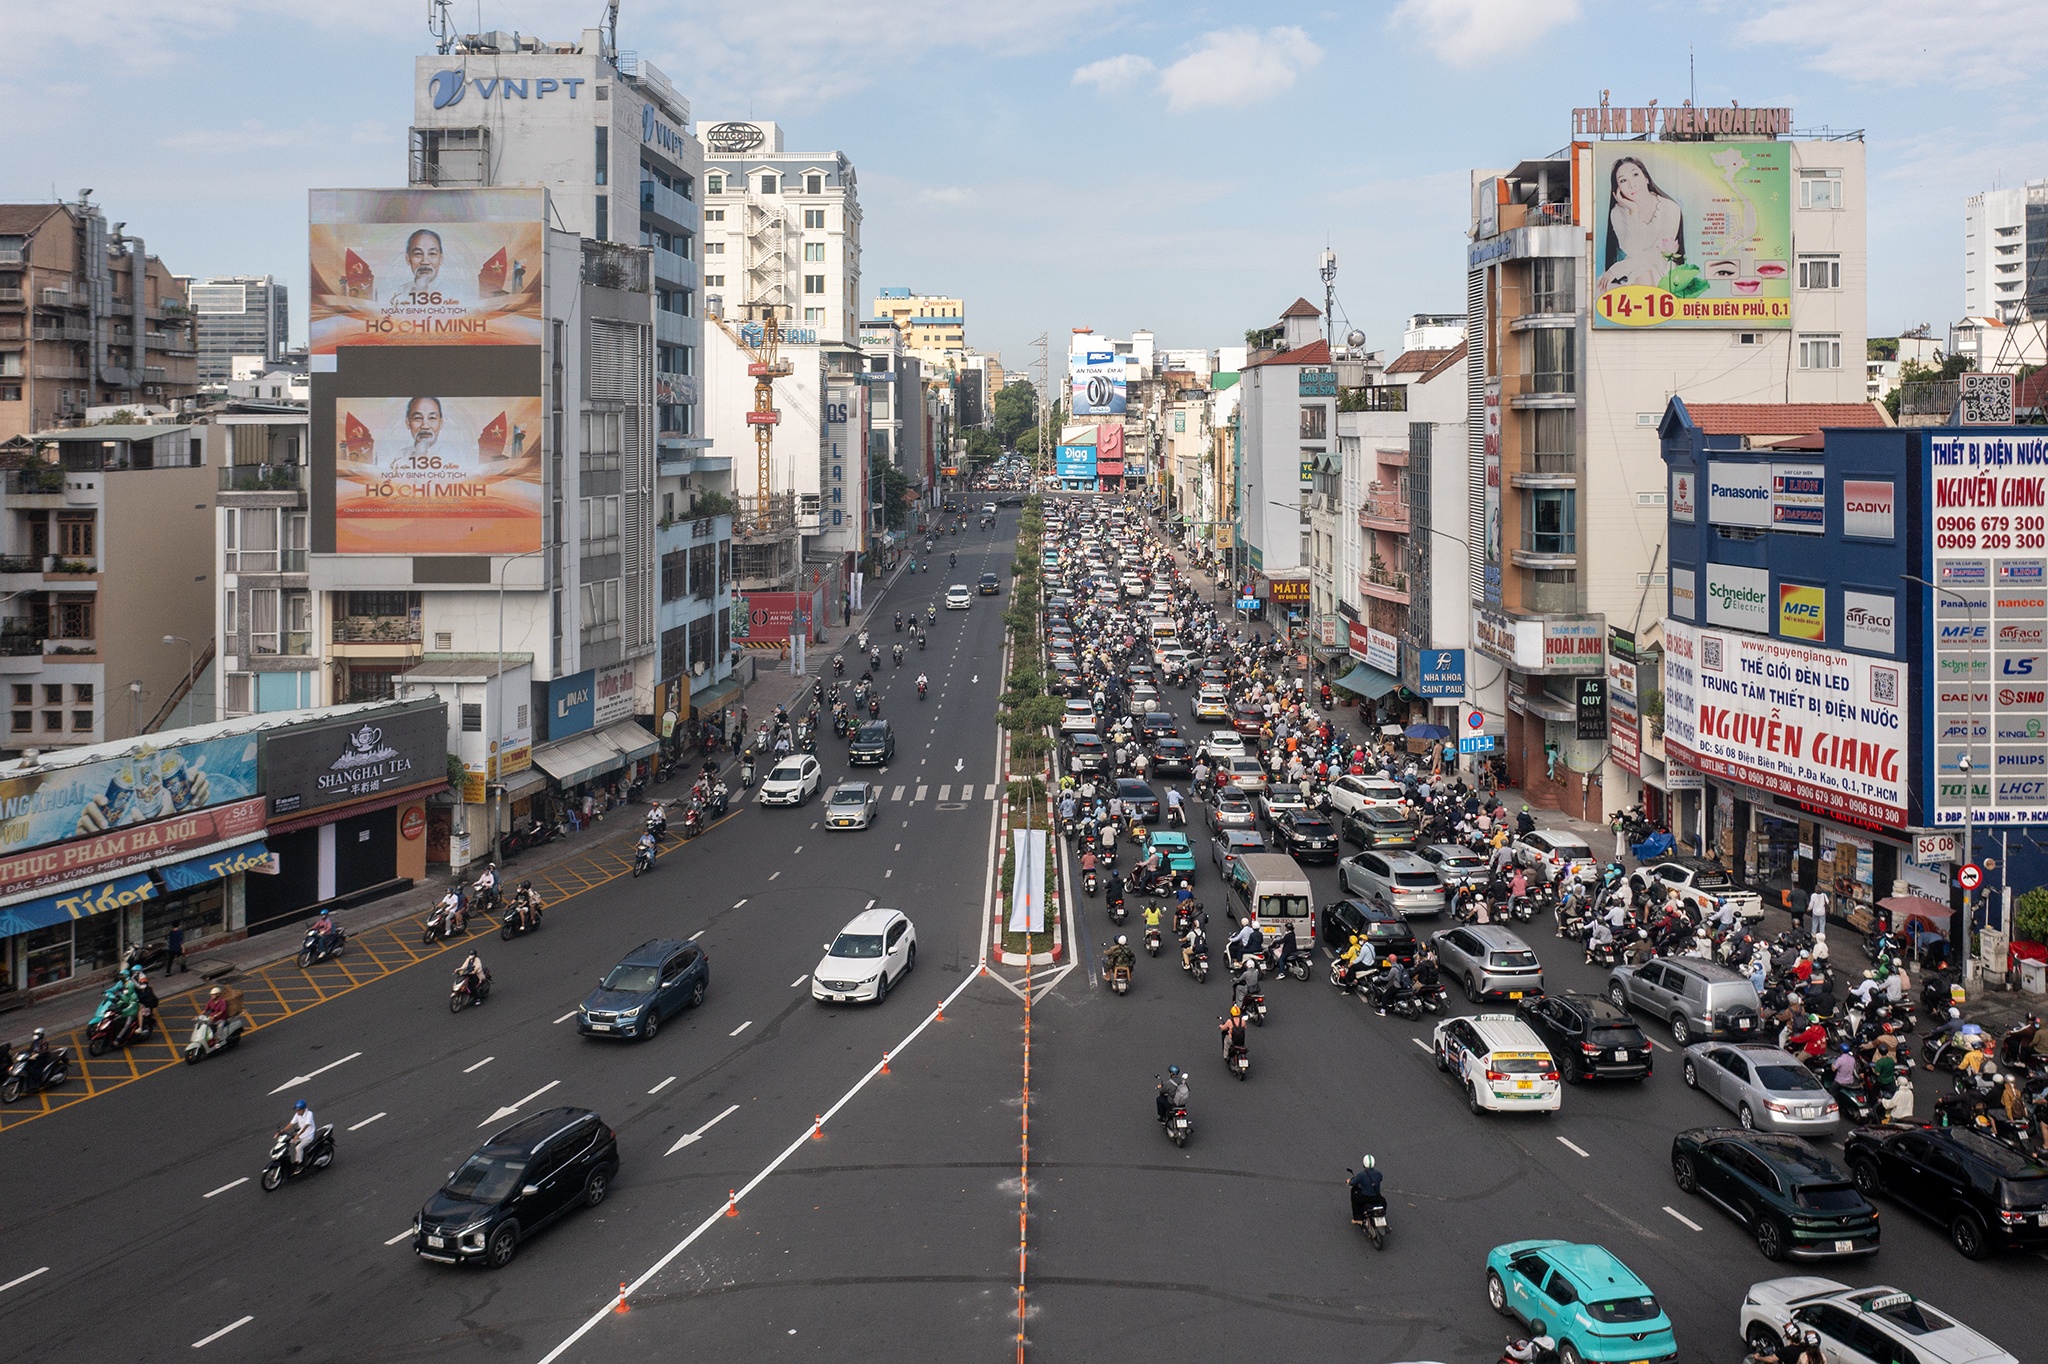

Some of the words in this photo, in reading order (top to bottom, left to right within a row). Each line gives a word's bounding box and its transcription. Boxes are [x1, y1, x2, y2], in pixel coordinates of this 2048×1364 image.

[473, 78, 585, 99] VNPT
[1573, 89, 1627, 134] THẨM
[1631, 99, 1658, 134] MỸ
[1708, 99, 1751, 134] HOÀI
[1754, 108, 1790, 134] ANH
[655, 119, 685, 160] VNPT
[708, 131, 762, 142] VINACONEX
[409, 292, 442, 305] 136
[1602, 294, 1674, 317] 14-16
[381, 306, 404, 314] NGÀY
[427, 305, 446, 314] CHỦ
[447, 307, 467, 316] TỊCH
[1683, 301, 1709, 318] ĐIỆN
[1713, 301, 1739, 316] BIÊN
[1743, 299, 1768, 317] PHỦ,
[1771, 303, 1788, 316] Q.1
[366, 314, 394, 333] HỒ
[398, 316, 431, 333] CHÍ
[435, 319, 486, 332] MINH
[788, 328, 817, 344] LAND
[1320, 385, 1336, 395] SPA
[827, 404, 848, 424] QS
[1932, 436, 1965, 466] THIẾT
[1969, 443, 1980, 469] BỊ
[1984, 439, 2013, 469] ĐIỆN
[410, 456, 442, 470] 136
[381, 470, 404, 479] NGÀY
[427, 470, 445, 479] CHỦ
[447, 471, 466, 480] TỊCH
[365, 479, 394, 497] HỒ
[398, 480, 430, 497] CHÍ
[435, 484, 486, 497] MINH
[833, 443, 842, 526] LAND
[1711, 484, 1769, 500] Panasonic
[1789, 479, 1819, 492] LION
[1936, 469, 1998, 507] NGUYỄN
[2001, 477, 2045, 507] GIANG
[1846, 502, 1891, 513] CADIVI
[1937, 516, 1976, 531] 0906
[1981, 516, 2010, 531] 679
[2015, 516, 2045, 531] 300
[1937, 534, 1976, 549] 0909
[1981, 534, 2011, 549] 209
[2015, 534, 2046, 549] 300
[2013, 568, 2039, 576] LION
[1274, 580, 1297, 594] MẮT
[1673, 587, 1693, 600] SENKO
[1709, 582, 1766, 604] Schneider
[1732, 601, 1765, 614] Electric
[1784, 602, 1820, 618] MPE
[1940, 600, 1987, 608] Panasonic
[1997, 599, 2045, 608] nanoco
[1846, 608, 1890, 628] anfaco
[1999, 628, 2041, 638] anfaco
[1546, 636, 1575, 654] HOÀI
[1578, 638, 1602, 654] ANH
[1741, 640, 1848, 667] www.nguyengiang.vn
[1740, 656, 1763, 675] THẾ
[1766, 661, 1791, 681] GIỚI
[1795, 666, 1821, 687] ĐÈN
[1825, 674, 1850, 692] LED
[2003, 659, 2033, 674] LS
[1442, 673, 1462, 681] KHOA
[1422, 685, 1443, 693] SAINT
[1446, 685, 1463, 693] PAUL
[1585, 680, 1598, 692] ẮC
[567, 688, 588, 707] INAX
[1582, 696, 1601, 705] QUY
[1701, 674, 1738, 695] TRUNG
[1742, 681, 1766, 701] TÂM
[1769, 688, 1805, 708] THIẾT
[1809, 697, 1821, 717] BỊ
[1825, 699, 1857, 722] ĐIỆN
[1861, 707, 1899, 730] NƯỚC
[1941, 694, 1988, 702] CADIVI
[2016, 691, 2045, 703] SINO
[1700, 705, 1803, 759] NGUYỄN
[1812, 731, 1900, 783] GIANG
[1999, 755, 2045, 765] PHILIPS
[318, 763, 383, 789] SHANGHAI
[388, 758, 412, 774] TEA
[1669, 767, 1685, 776] ĐÈN
[1687, 769, 1702, 777] LED
[1700, 740, 1713, 753] ĐC:
[1714, 743, 1725, 755] Số
[1725, 746, 1736, 759] 08
[1737, 748, 1755, 765] Điện
[1758, 754, 1775, 770] Biên
[1778, 760, 1796, 777] Phủ,
[1798, 766, 1817, 781] P.Đa
[1819, 772, 1839, 788] Kao,
[1842, 778, 1859, 795] Q.1,
[1862, 782, 1898, 803] TP.HCM
[1701, 757, 1727, 775] HOTLINE:
[1748, 770, 1764, 785] 0909
[1765, 774, 1778, 789] 209
[1779, 779, 1791, 793] 300
[1797, 785, 1814, 799] 0906
[1815, 789, 1829, 803] 679
[1830, 793, 1843, 808] 300
[1849, 799, 1867, 814] 0906
[1869, 804, 1883, 818] 819
[1885, 809, 1899, 824] 300
[1999, 782, 2045, 793] LHCT
[233, 804, 247, 818] Số
[250, 805, 254, 815] 1
[1937, 813, 1942, 822] 8
[1945, 813, 1962, 822] ĐBP
[1988, 812, 2010, 823] ĐỊNH
[2017, 812, 2030, 821] TP.
[4, 821, 29, 844] VUI
[1, 852, 57, 881] THỰC
[64, 836, 126, 867] PHẨM
[132, 829, 160, 850] HÀ
[165, 820, 197, 842] NỘI
[1919, 837, 1936, 853] Số
[1939, 838, 1954, 851] 08
[36, 873, 59, 885] SẢN
[63, 866, 94, 879] VÙNG
[97, 858, 124, 872] MIỀN
[127, 851, 152, 864] PHÍA
[155, 845, 177, 857] BẮC
[209, 852, 269, 877] Tiger
[56, 880, 154, 920] Tiger
